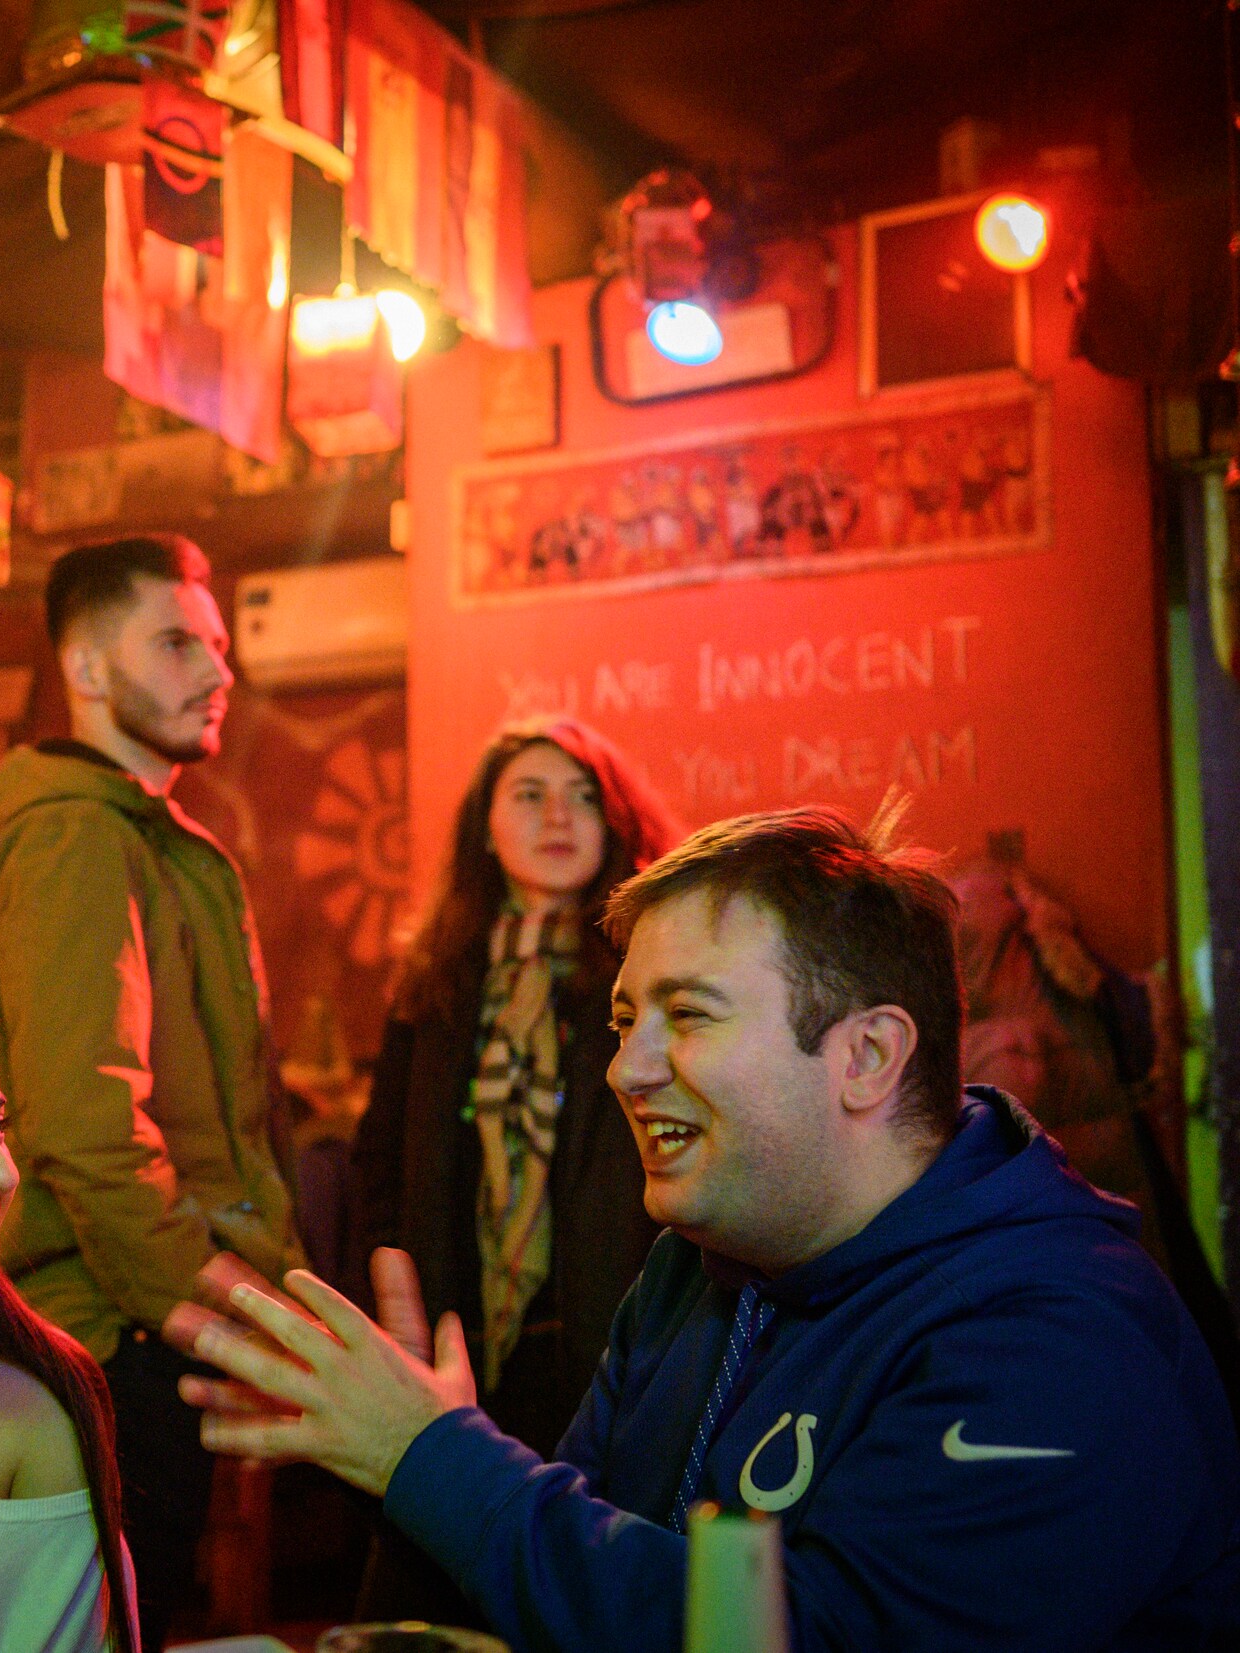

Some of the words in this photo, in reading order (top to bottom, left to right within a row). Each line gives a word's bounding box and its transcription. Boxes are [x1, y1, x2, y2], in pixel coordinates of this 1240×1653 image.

[593, 659, 673, 714] ARE
[698, 614, 981, 712] INNOCENT
[672, 744, 757, 800] YOU
[782, 725, 976, 796] DREAM
